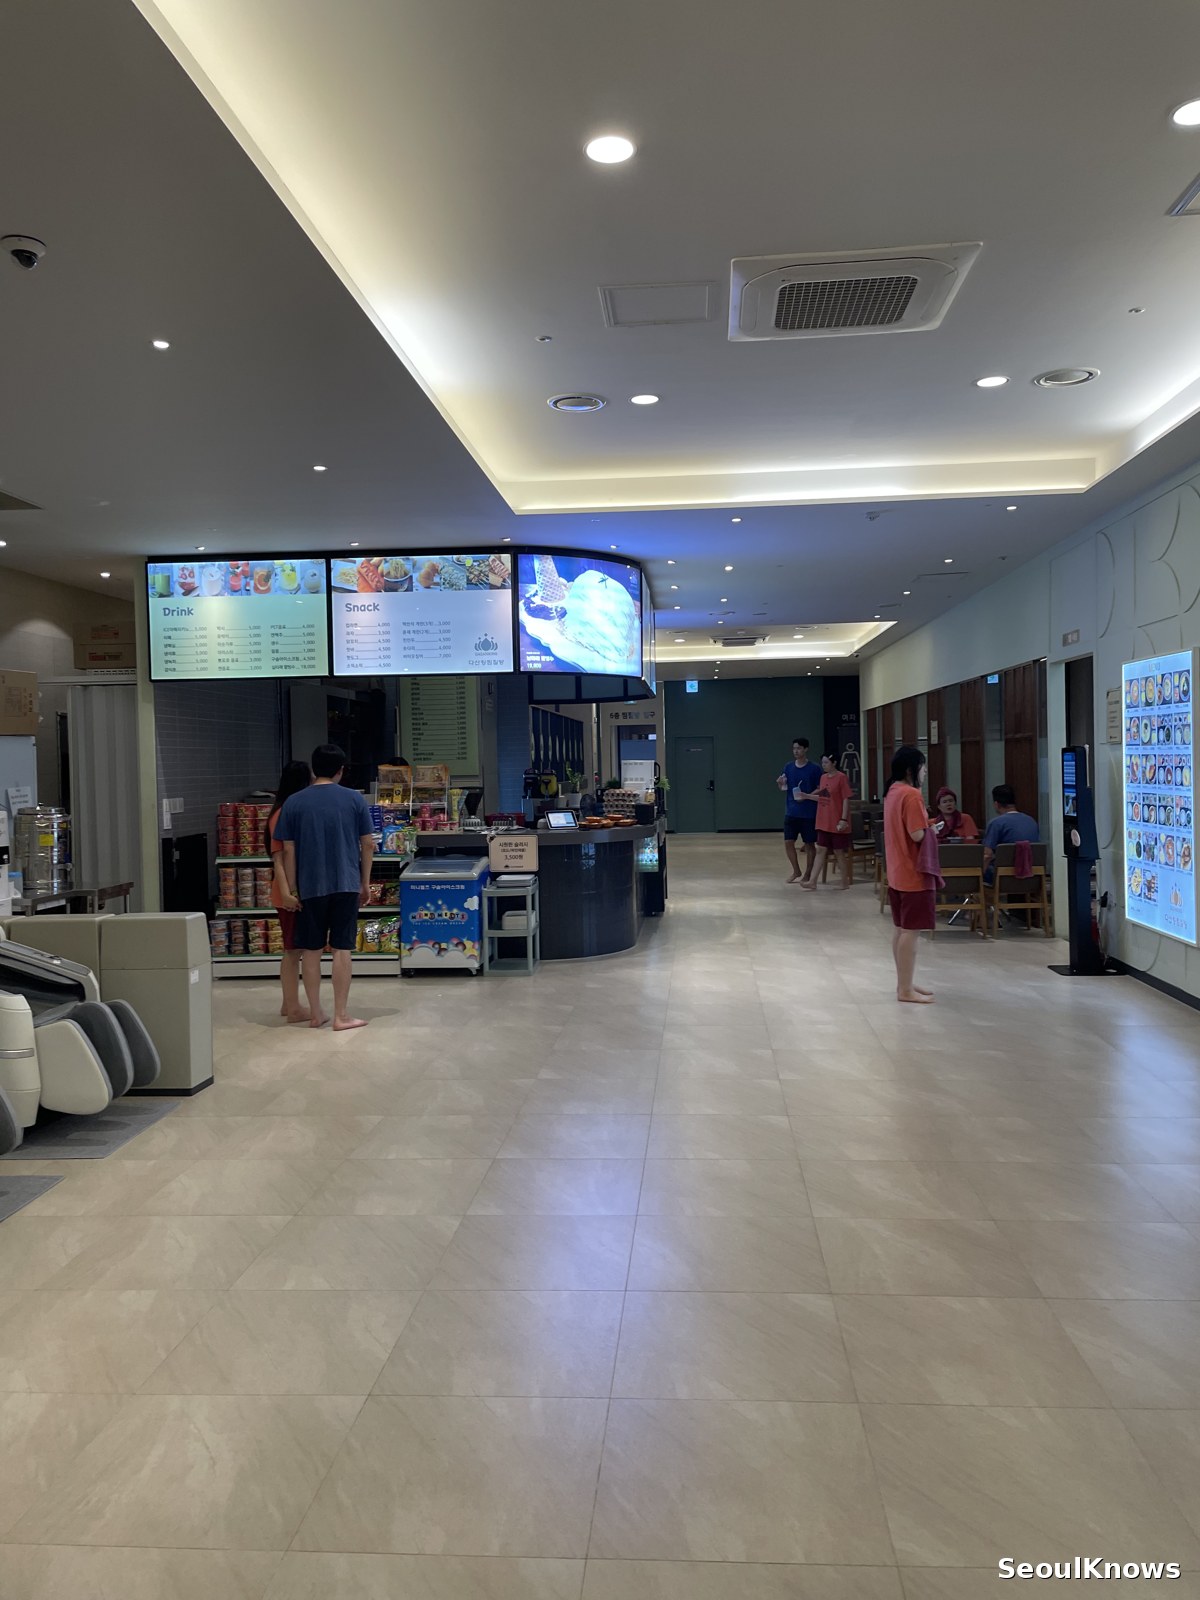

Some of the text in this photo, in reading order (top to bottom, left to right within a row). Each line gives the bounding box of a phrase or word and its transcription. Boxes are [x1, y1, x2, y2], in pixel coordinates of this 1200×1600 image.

[162, 607, 194, 617] Drink
[345, 603, 380, 612] Snack
[437, 911, 466, 921] MELTS
